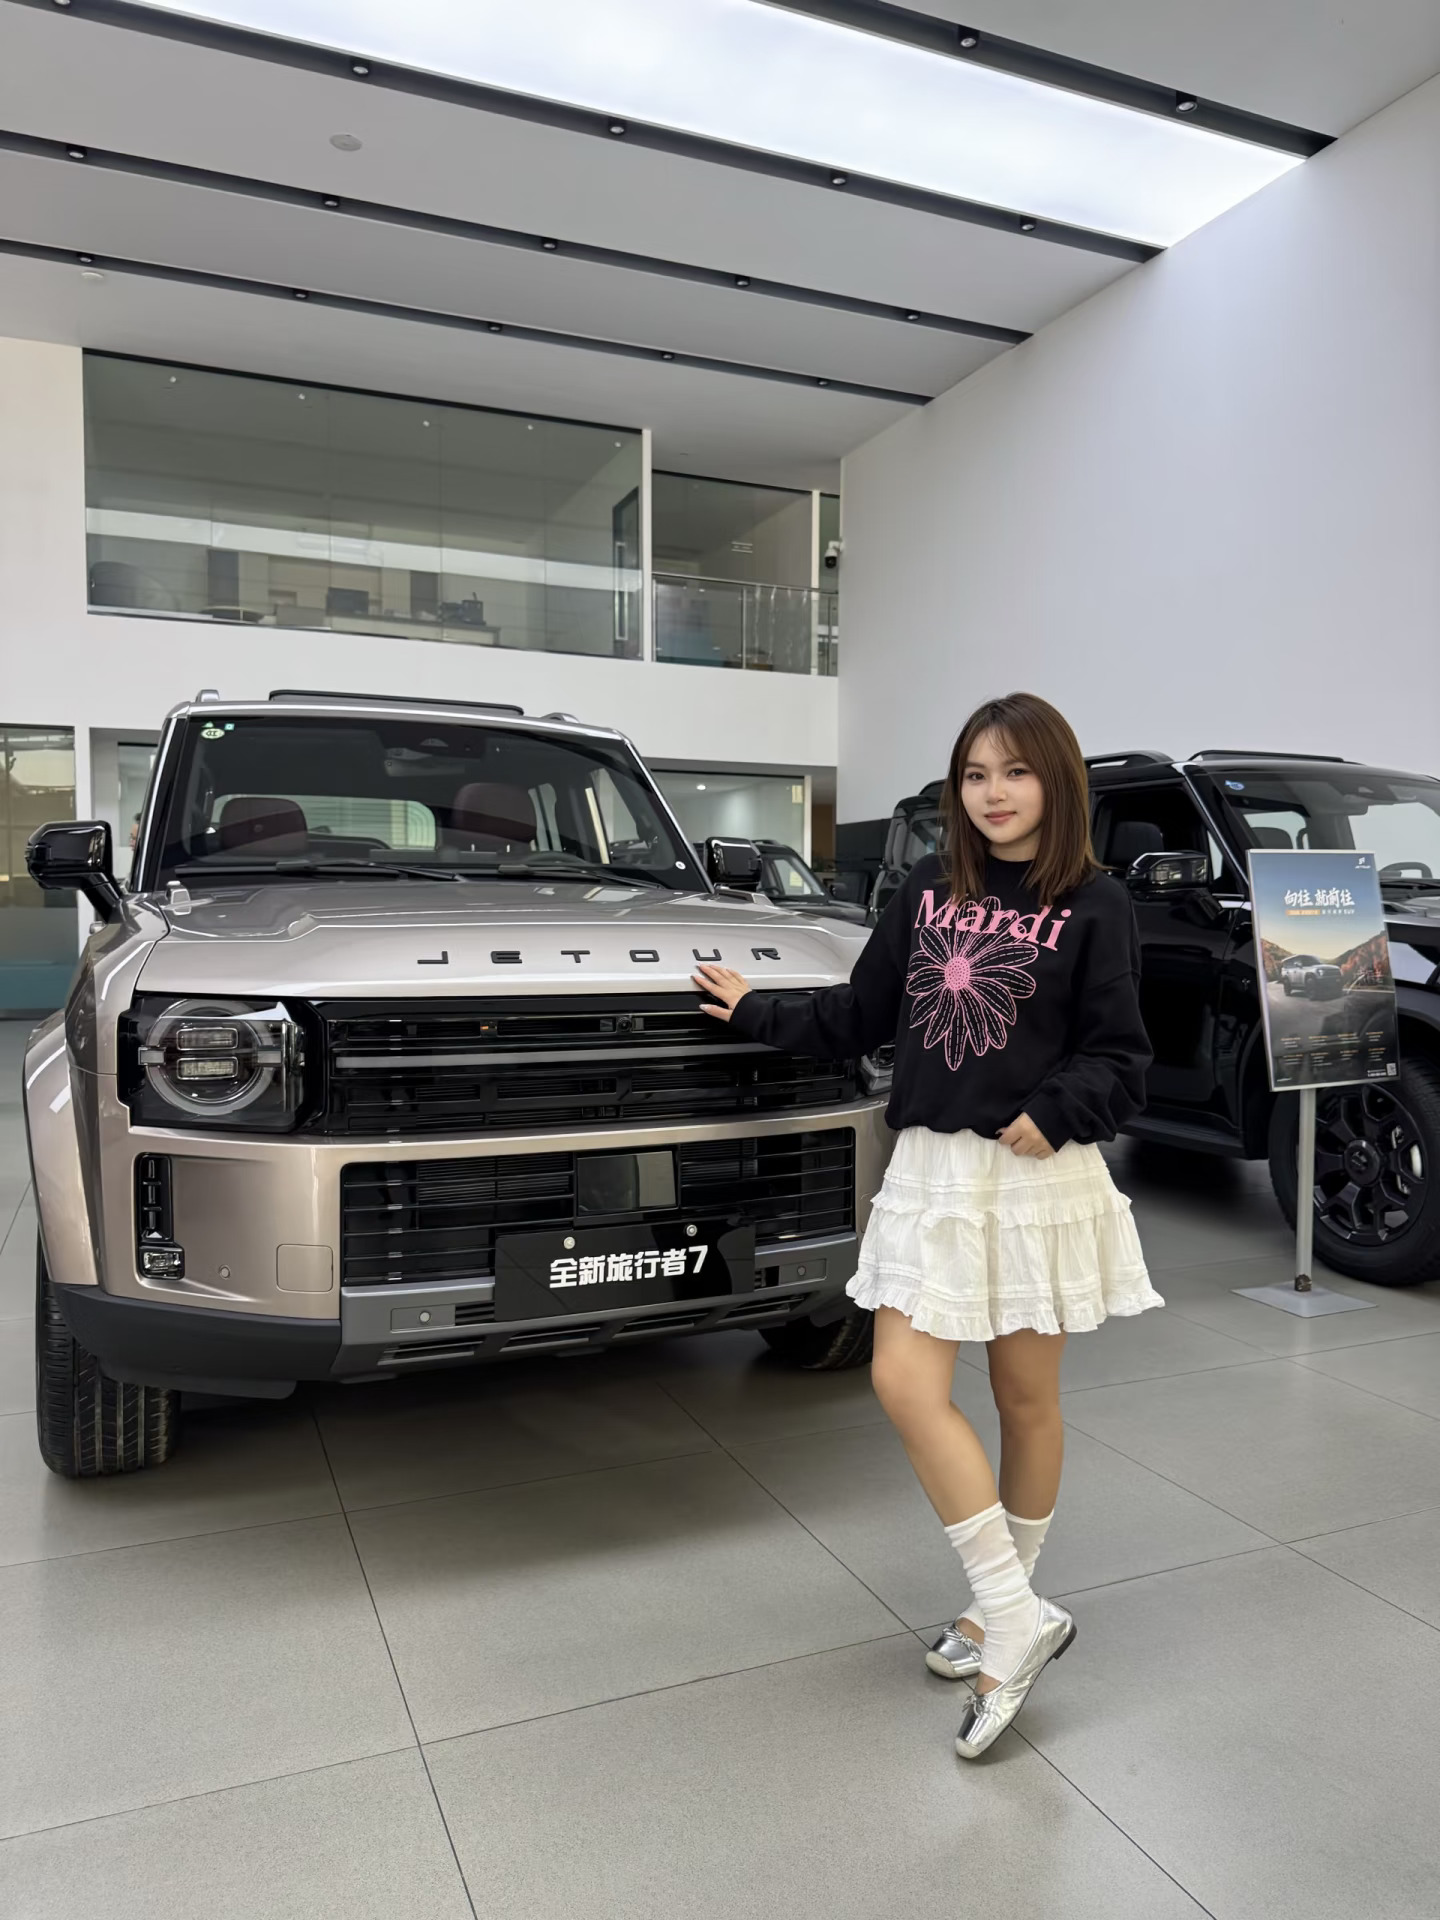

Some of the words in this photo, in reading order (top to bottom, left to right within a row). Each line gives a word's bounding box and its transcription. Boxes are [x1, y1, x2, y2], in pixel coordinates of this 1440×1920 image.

[1284, 889, 1314, 907] 向往
[914, 889, 1072, 951] Mardi
[417, 947, 781, 965] JETOUR
[549, 1245, 708, 1288] 全新旅行者7
